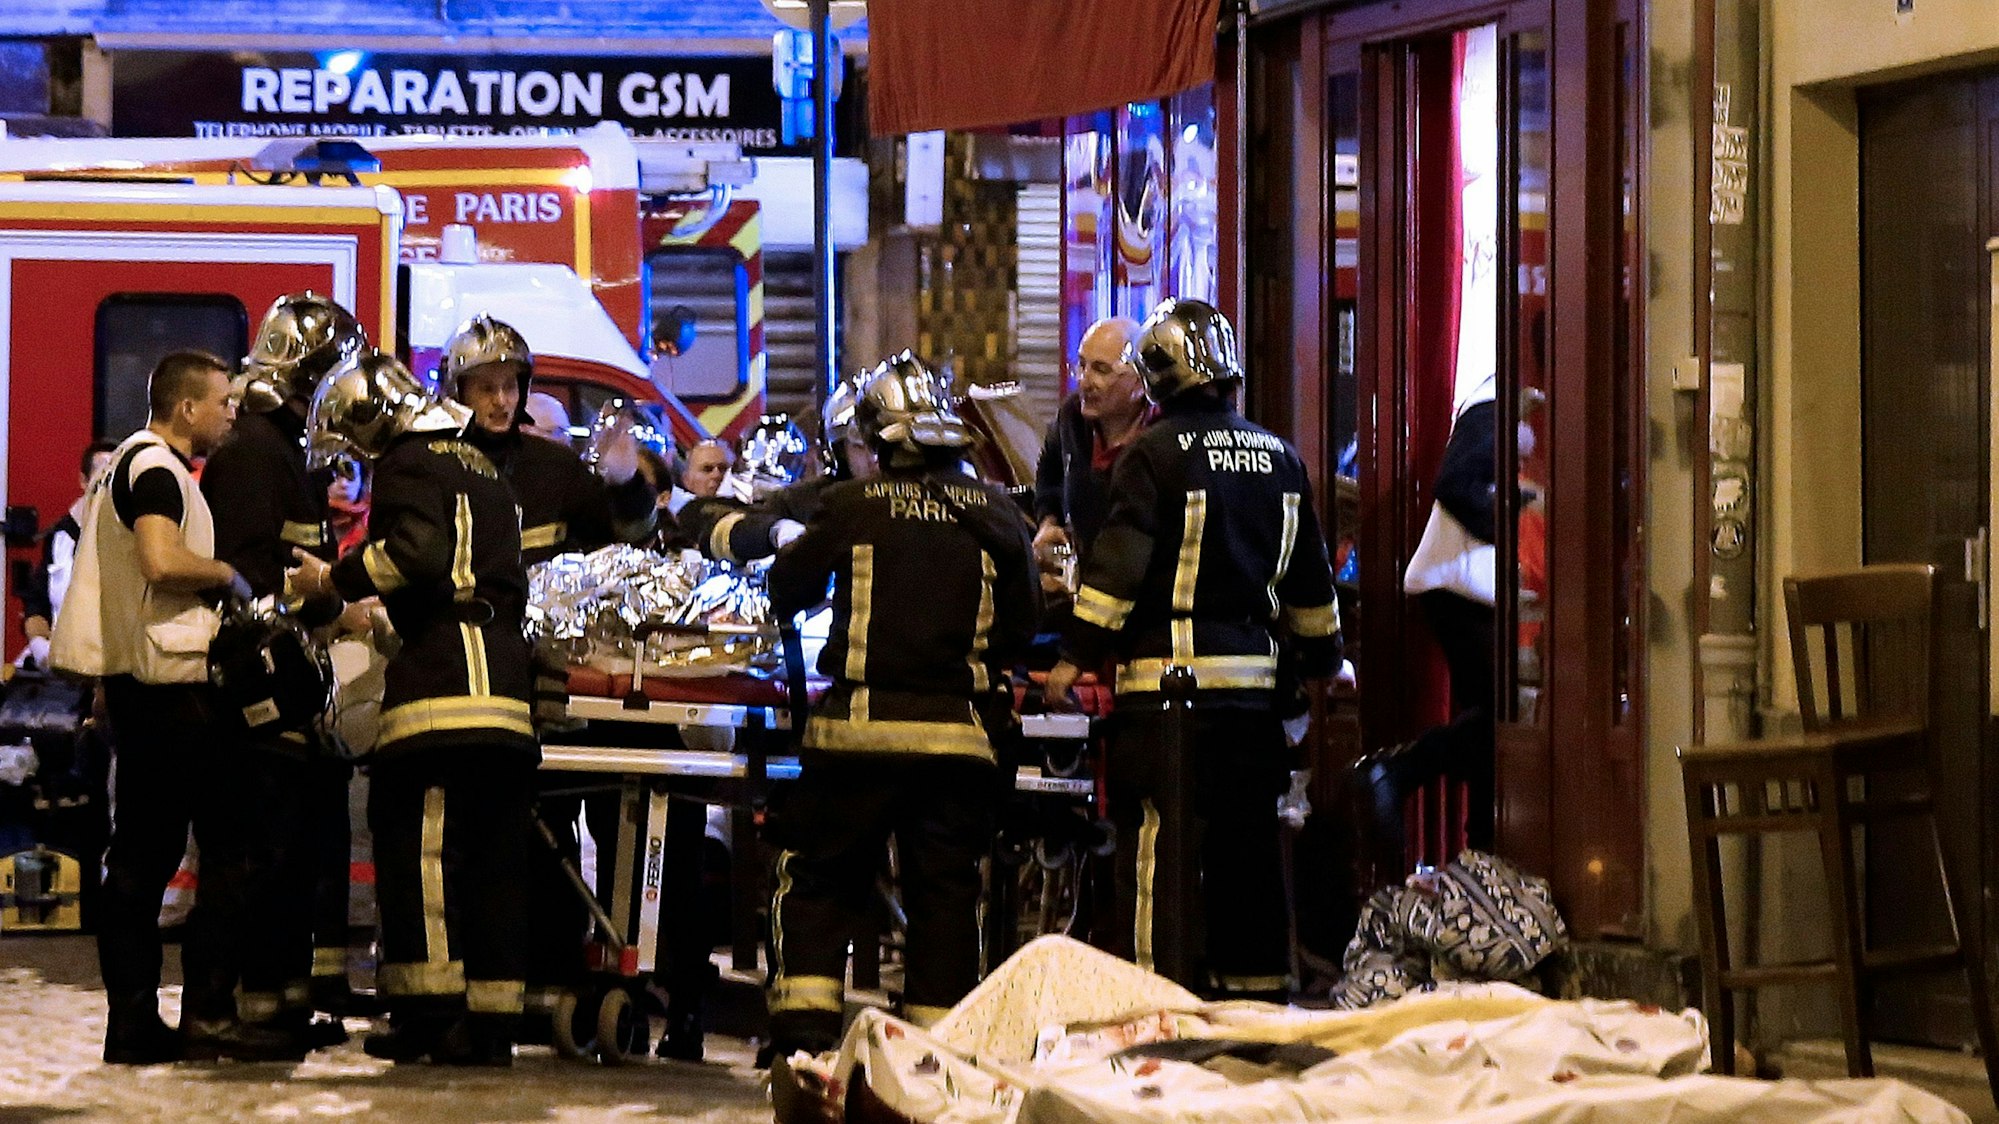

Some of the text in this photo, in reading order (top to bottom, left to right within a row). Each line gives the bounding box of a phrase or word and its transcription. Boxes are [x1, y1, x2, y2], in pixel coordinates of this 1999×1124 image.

[241, 67, 731, 118] REPARATION GSM
[653, 127, 778, 148] ACCESSOIRES
[454, 191, 562, 223] PARIS
[1207, 448, 1273, 474] PARIS
